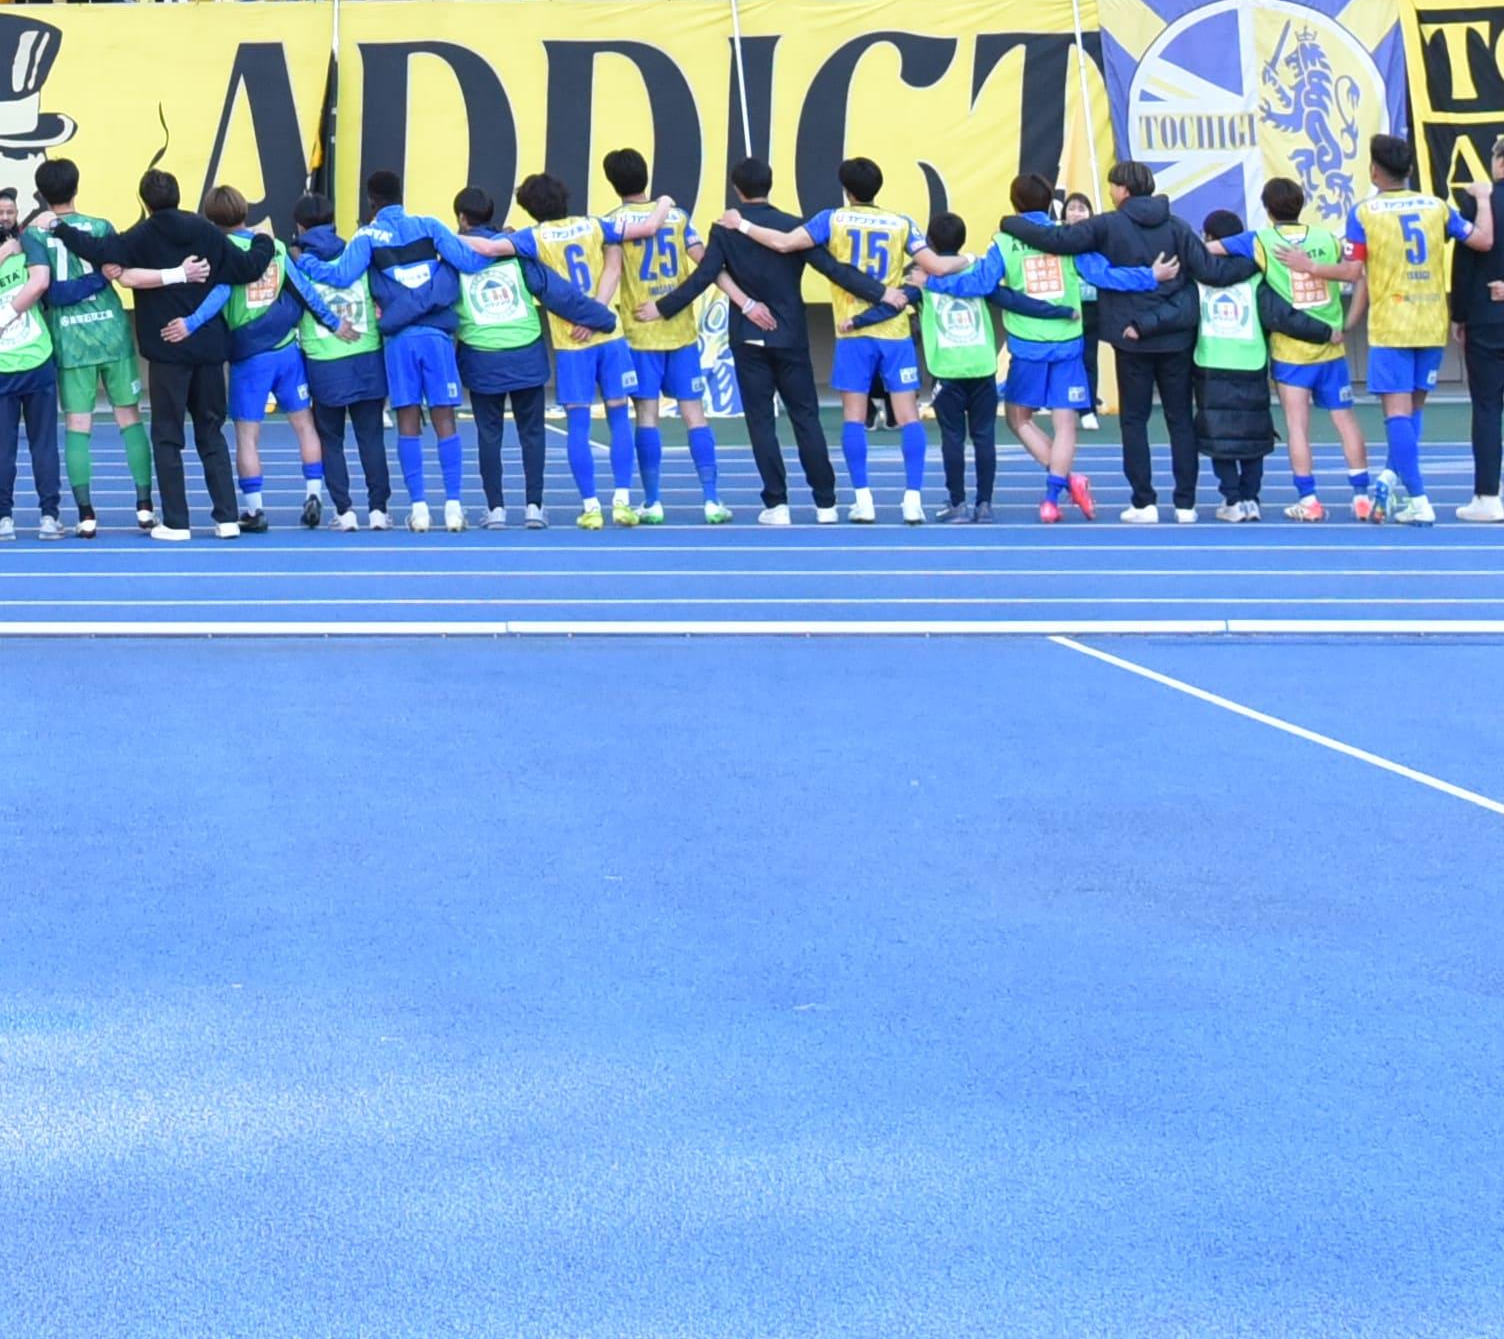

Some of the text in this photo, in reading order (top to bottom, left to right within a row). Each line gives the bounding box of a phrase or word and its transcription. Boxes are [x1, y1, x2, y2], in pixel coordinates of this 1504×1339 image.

[199, 31, 1104, 240] ADDICT
[1138, 113, 1258, 150] TOCHIGI
[632, 226, 679, 283] 25
[846, 228, 891, 281] 15
[1398, 212, 1428, 268] 5
[562, 243, 594, 294] 6
